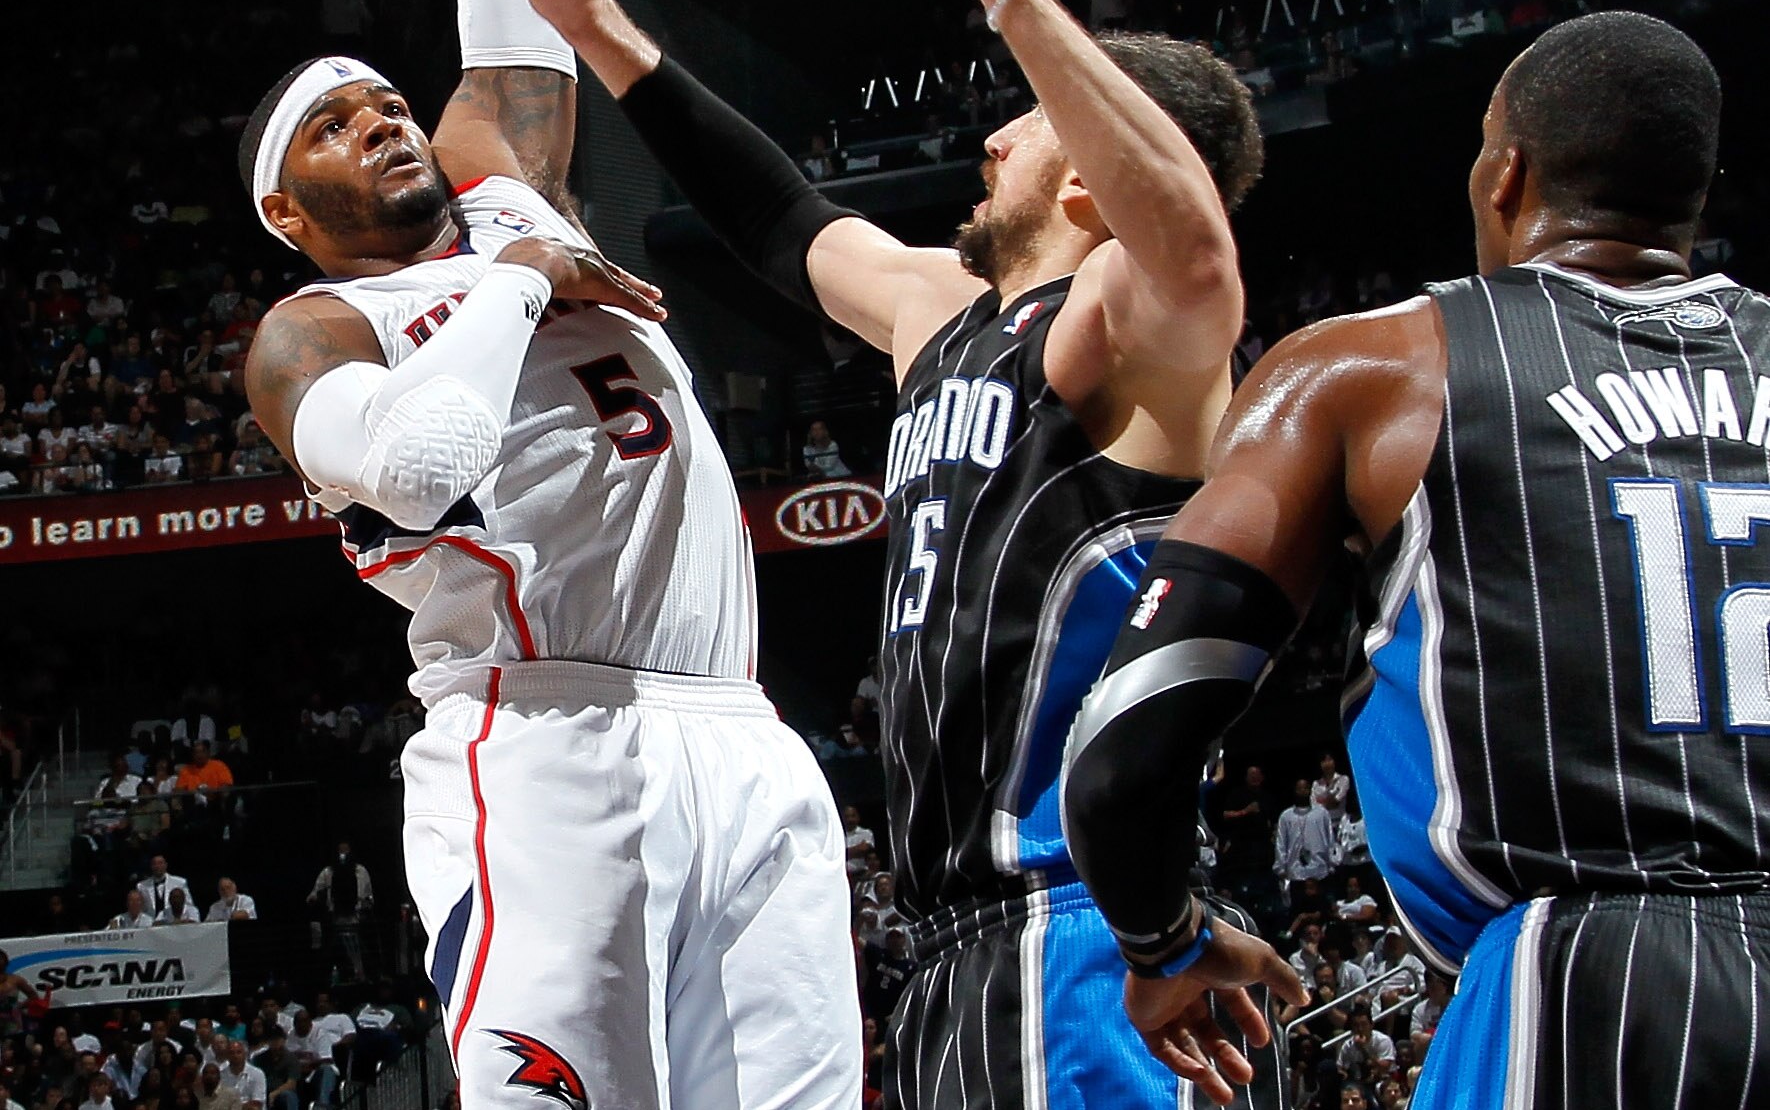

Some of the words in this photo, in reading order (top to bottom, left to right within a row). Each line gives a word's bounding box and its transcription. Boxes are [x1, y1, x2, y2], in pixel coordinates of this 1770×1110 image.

[569, 352, 672, 460] 5
[31, 516, 141, 546] learn
[158, 503, 266, 534] more
[796, 495, 871, 533] KIA
[1607, 476, 1770, 733] 12
[64, 933, 121, 944] PRESENTED
[122, 931, 135, 941] BY
[36, 958, 185, 991] SCANA
[127, 985, 185, 1000] ENERGY
